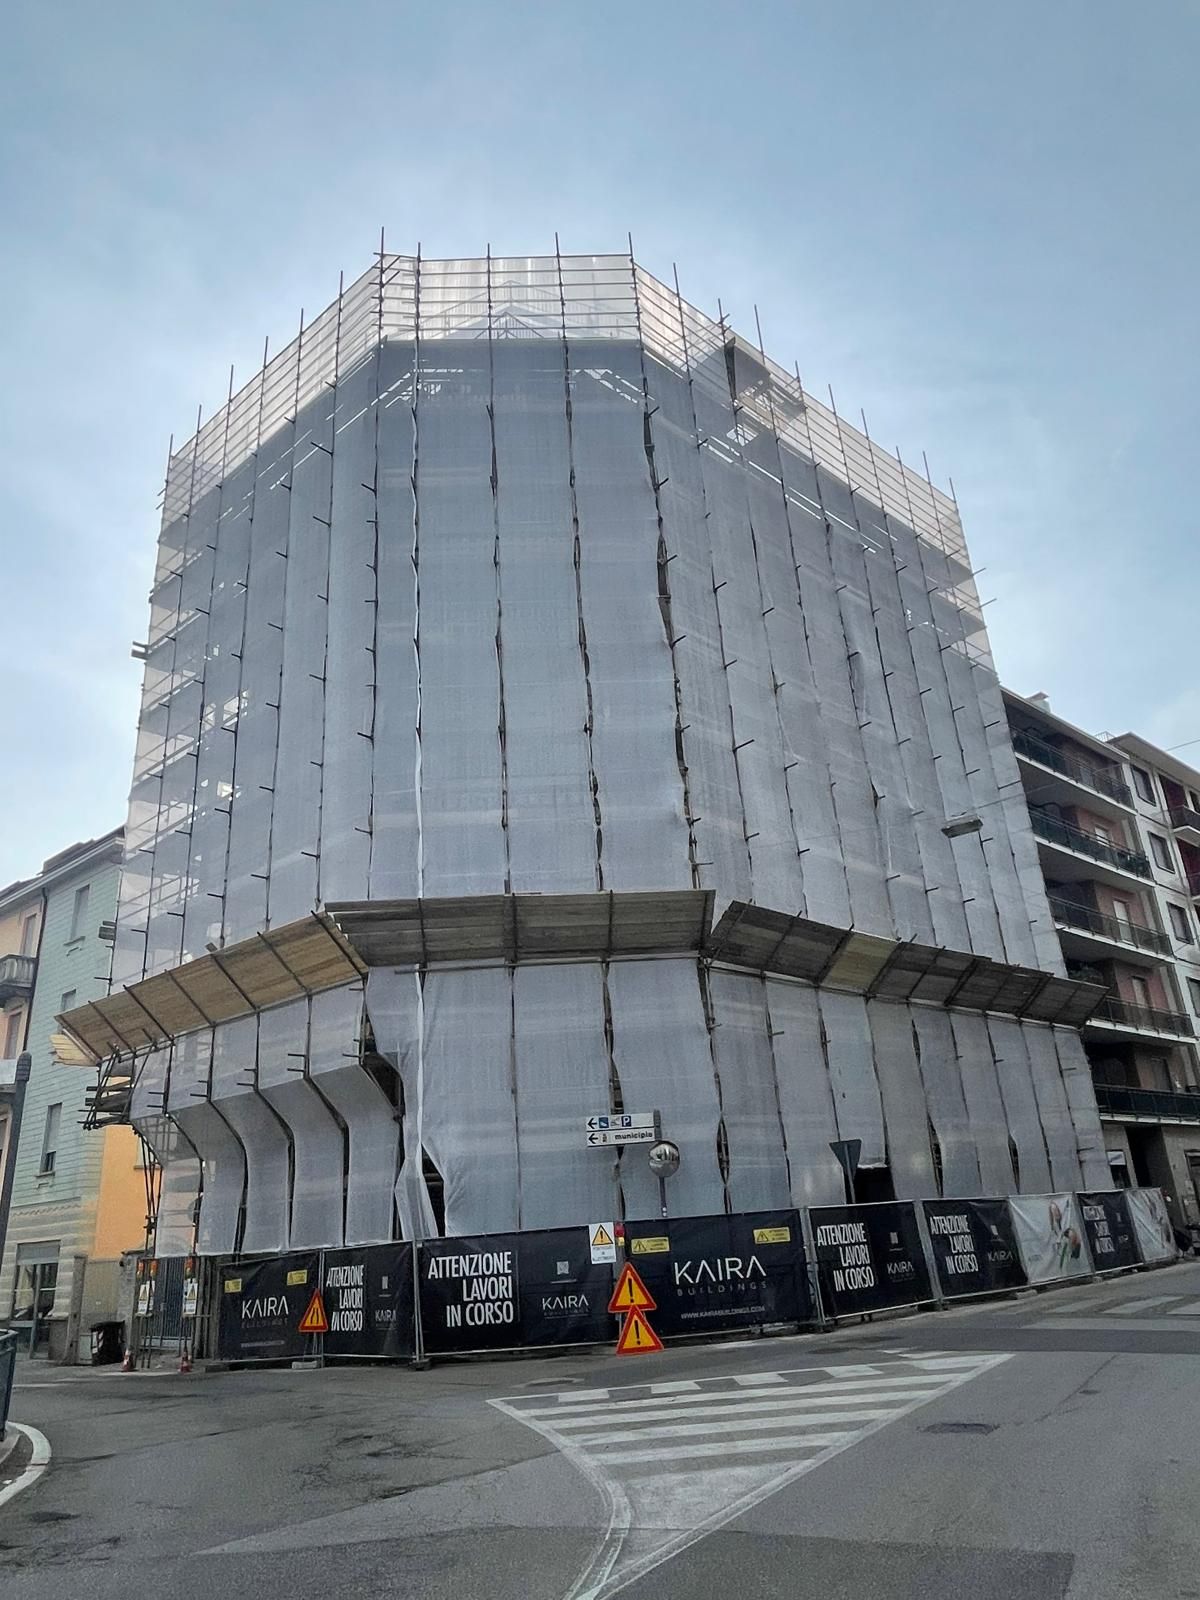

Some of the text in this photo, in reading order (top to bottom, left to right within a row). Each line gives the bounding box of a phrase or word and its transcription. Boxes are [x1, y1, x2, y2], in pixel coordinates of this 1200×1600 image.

[614, 1131, 653, 1140] municipio
[817, 1223, 867, 1246] ATTENZIONE
[929, 1215, 970, 1234] ATTENZIONE
[428, 1252, 512, 1279] ATTENZIONE
[839, 1245, 870, 1267] LAVORI
[945, 1254, 979, 1275] IN CORSO
[326, 1265, 364, 1287] ATTENZIONE
[674, 1255, 767, 1285] KAIRA
[833, 1267, 875, 1292] IN CORSO
[339, 1288, 363, 1309] LAVORI
[463, 1276, 513, 1302] LAVORI
[677, 1280, 767, 1297] BUILDINGS
[242, 1295, 289, 1319] KAIRA
[542, 1295, 589, 1310] KAIRA
[331, 1311, 340, 1331] IN
[340, 1310, 363, 1331] CORSO
[446, 1301, 514, 1328] IN CORSO
